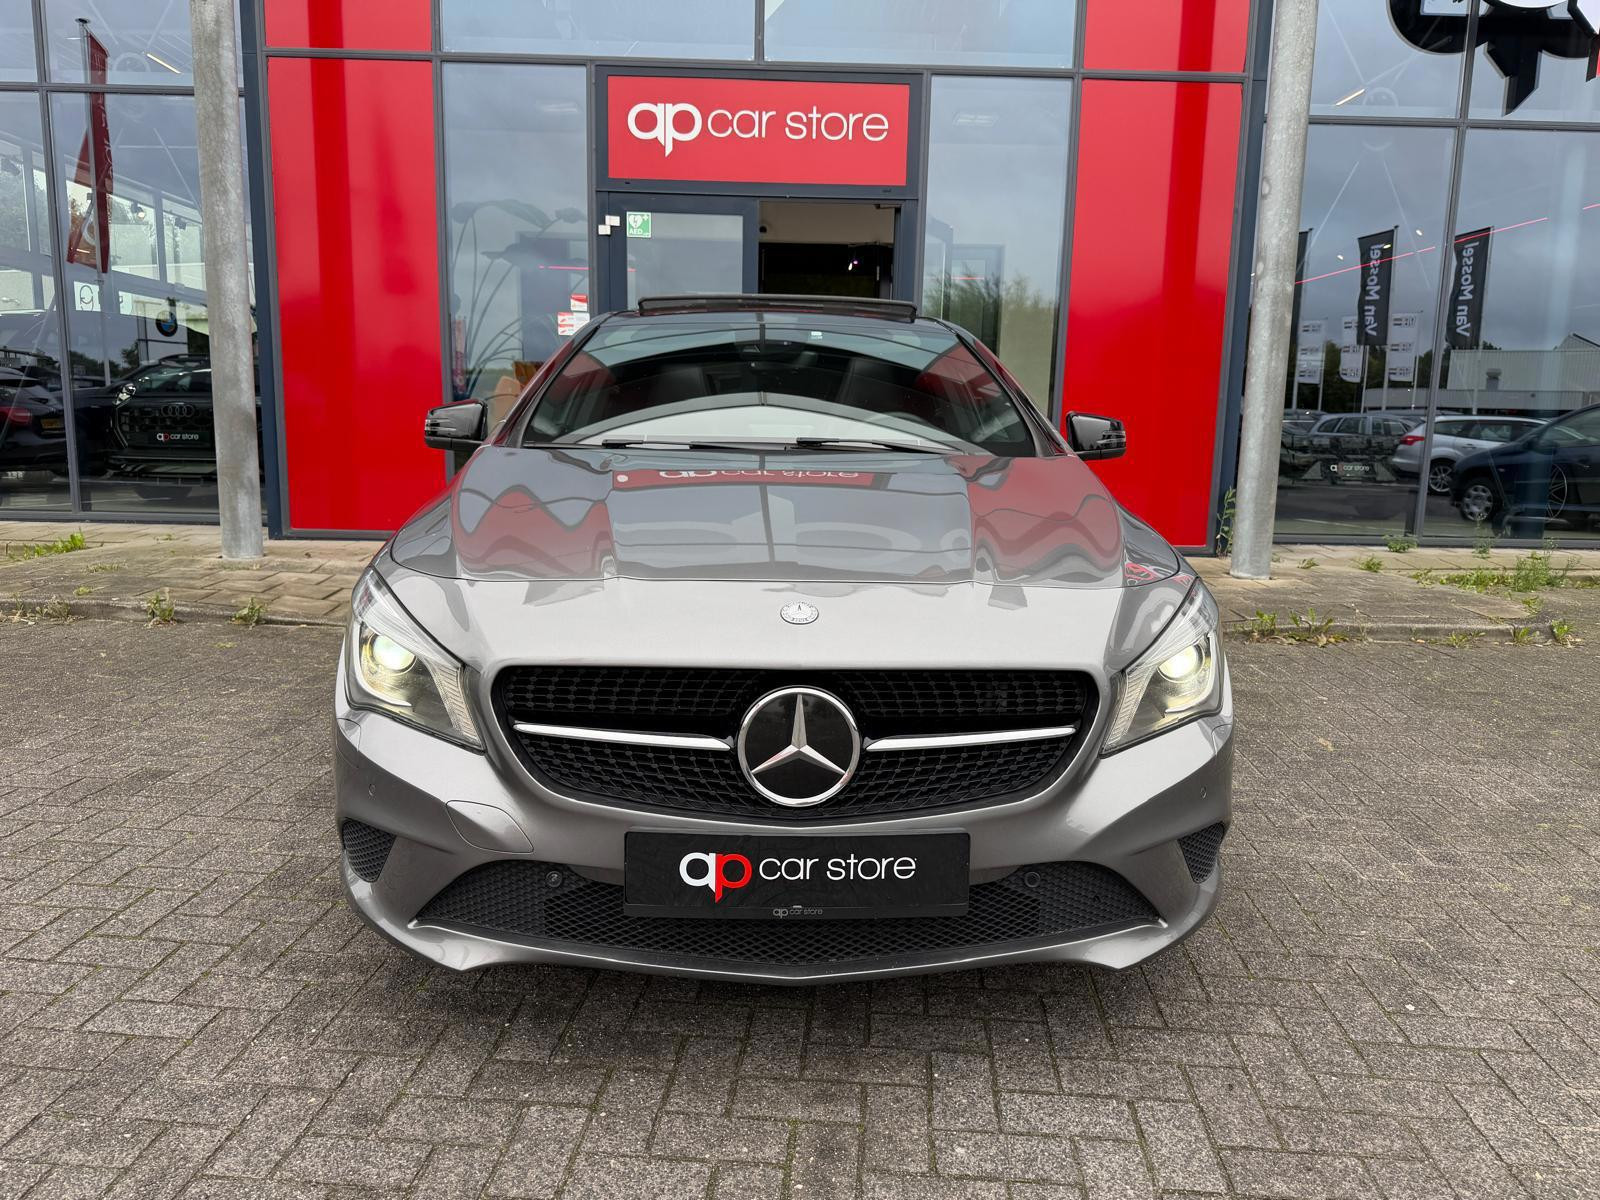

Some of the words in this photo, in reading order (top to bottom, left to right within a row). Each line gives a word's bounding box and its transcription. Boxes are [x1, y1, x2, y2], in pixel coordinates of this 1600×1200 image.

[627, 102, 702, 157] ap
[707, 108, 776, 138] car
[784, 105, 889, 142] store
[679, 852, 753, 904] ap
[758, 857, 819, 881] car
[826, 853, 917, 881] store
